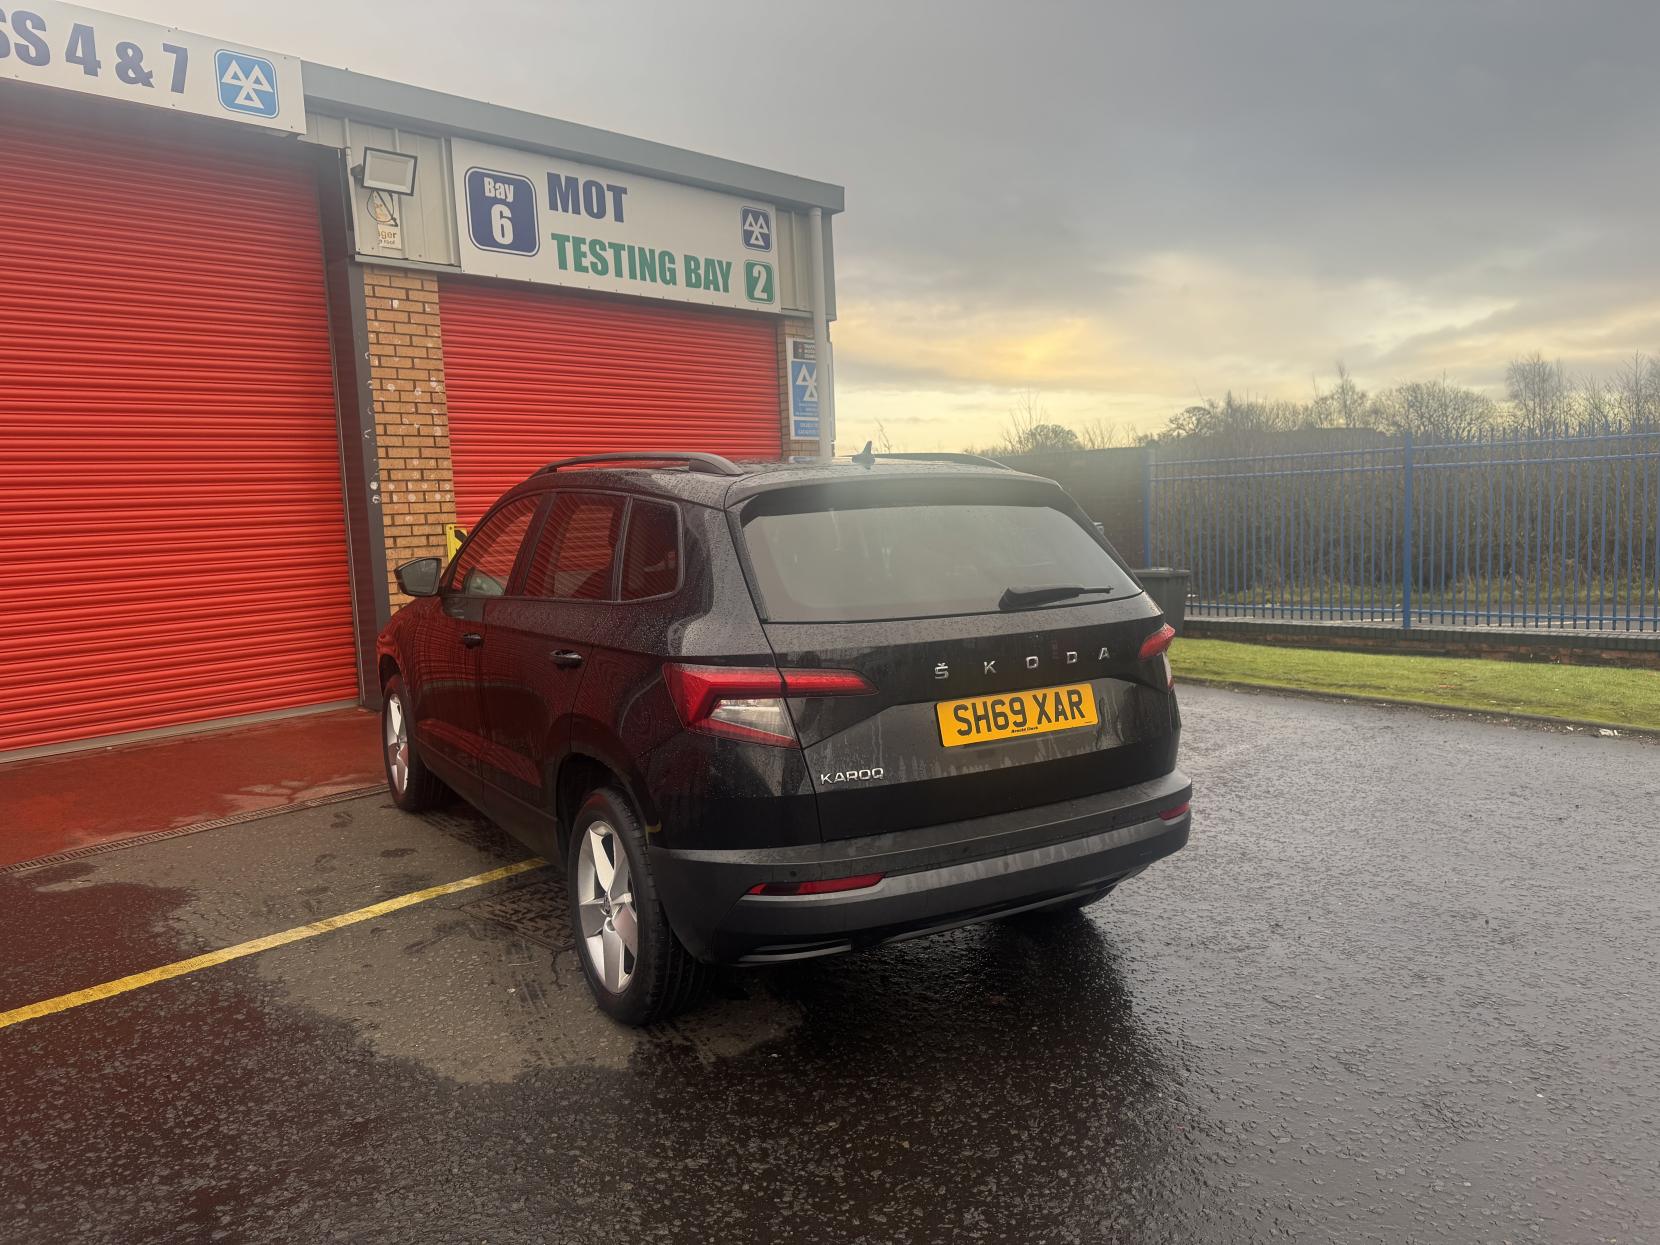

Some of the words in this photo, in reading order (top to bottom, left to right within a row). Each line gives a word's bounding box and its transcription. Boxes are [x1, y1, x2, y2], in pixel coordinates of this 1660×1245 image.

[0, 8, 50, 67] S
[65, 22, 101, 77] 4
[115, 41, 154, 88] &
[162, 43, 188, 94] 7
[484, 177, 514, 202] Bay
[547, 172, 628, 223] MOT
[491, 204, 514, 245] 6
[551, 233, 676, 286] TESTING
[684, 254, 732, 293] BAY
[752, 264, 769, 299] 2
[953, 696, 1028, 737] SH69
[1032, 688, 1085, 725] XAR
[820, 767, 884, 785] KAROQ
